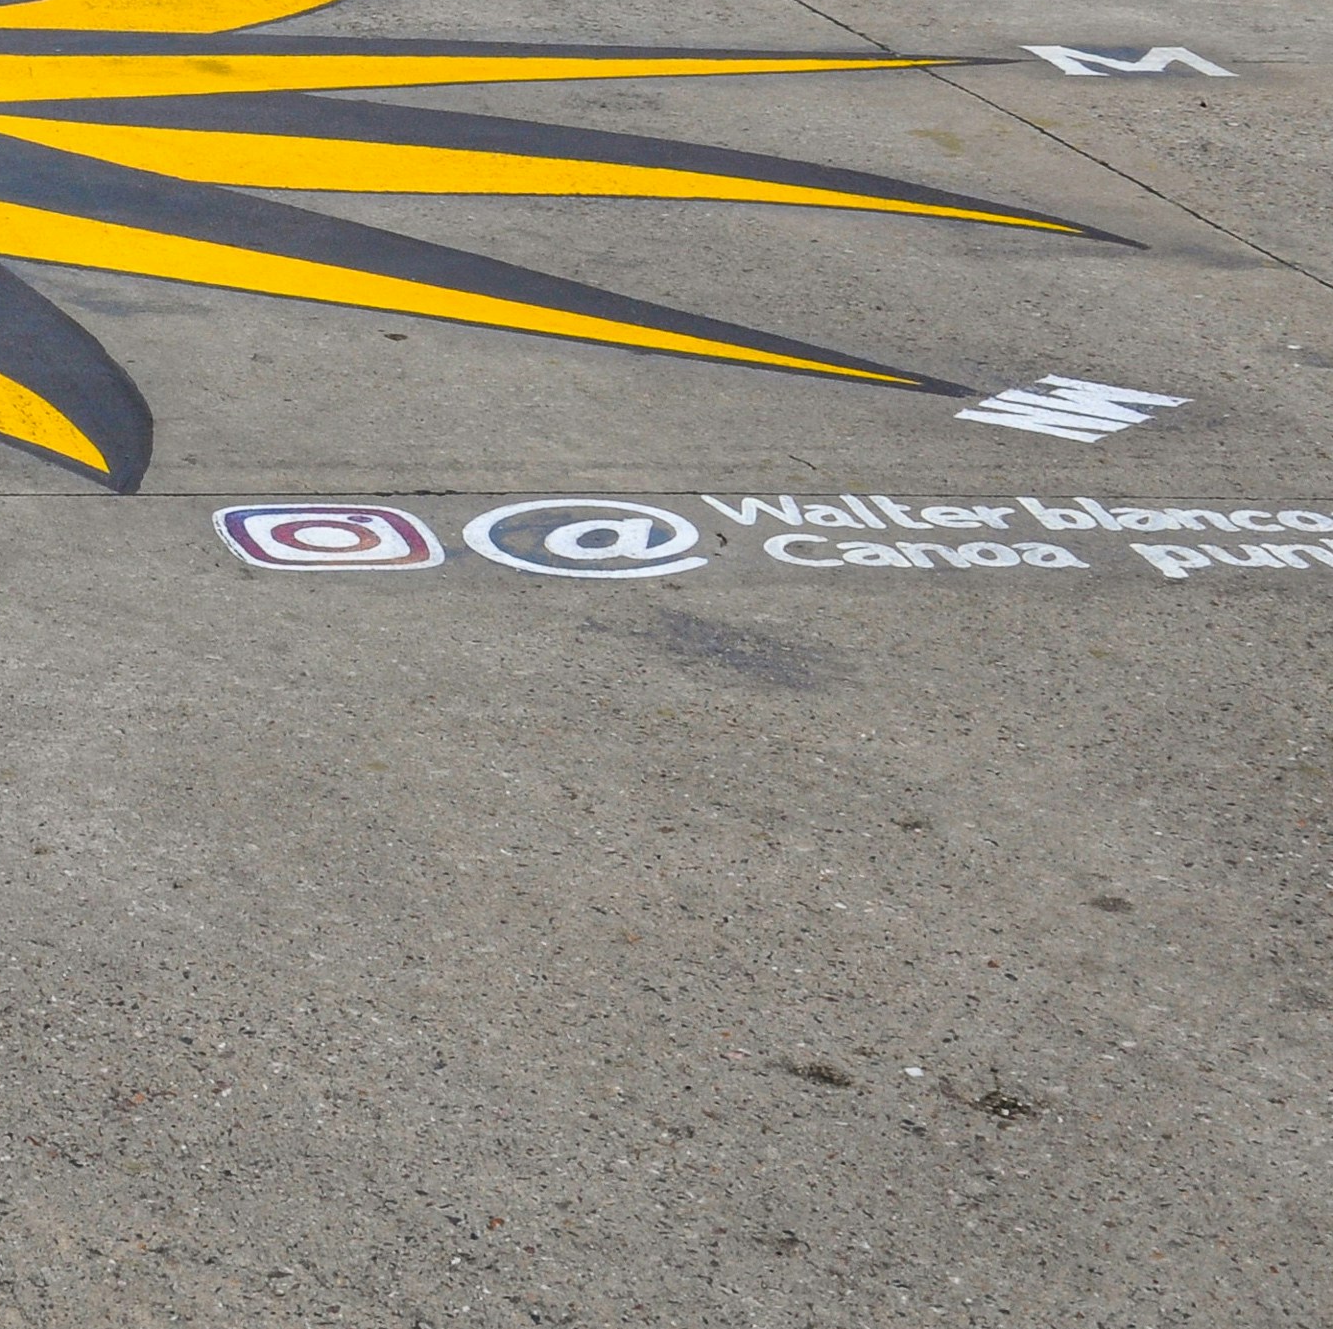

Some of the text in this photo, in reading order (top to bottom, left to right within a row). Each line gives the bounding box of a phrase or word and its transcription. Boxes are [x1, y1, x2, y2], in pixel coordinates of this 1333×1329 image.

[700, 494, 1016, 530] Walter
[763, 533, 1333, 579] Canoa pun
